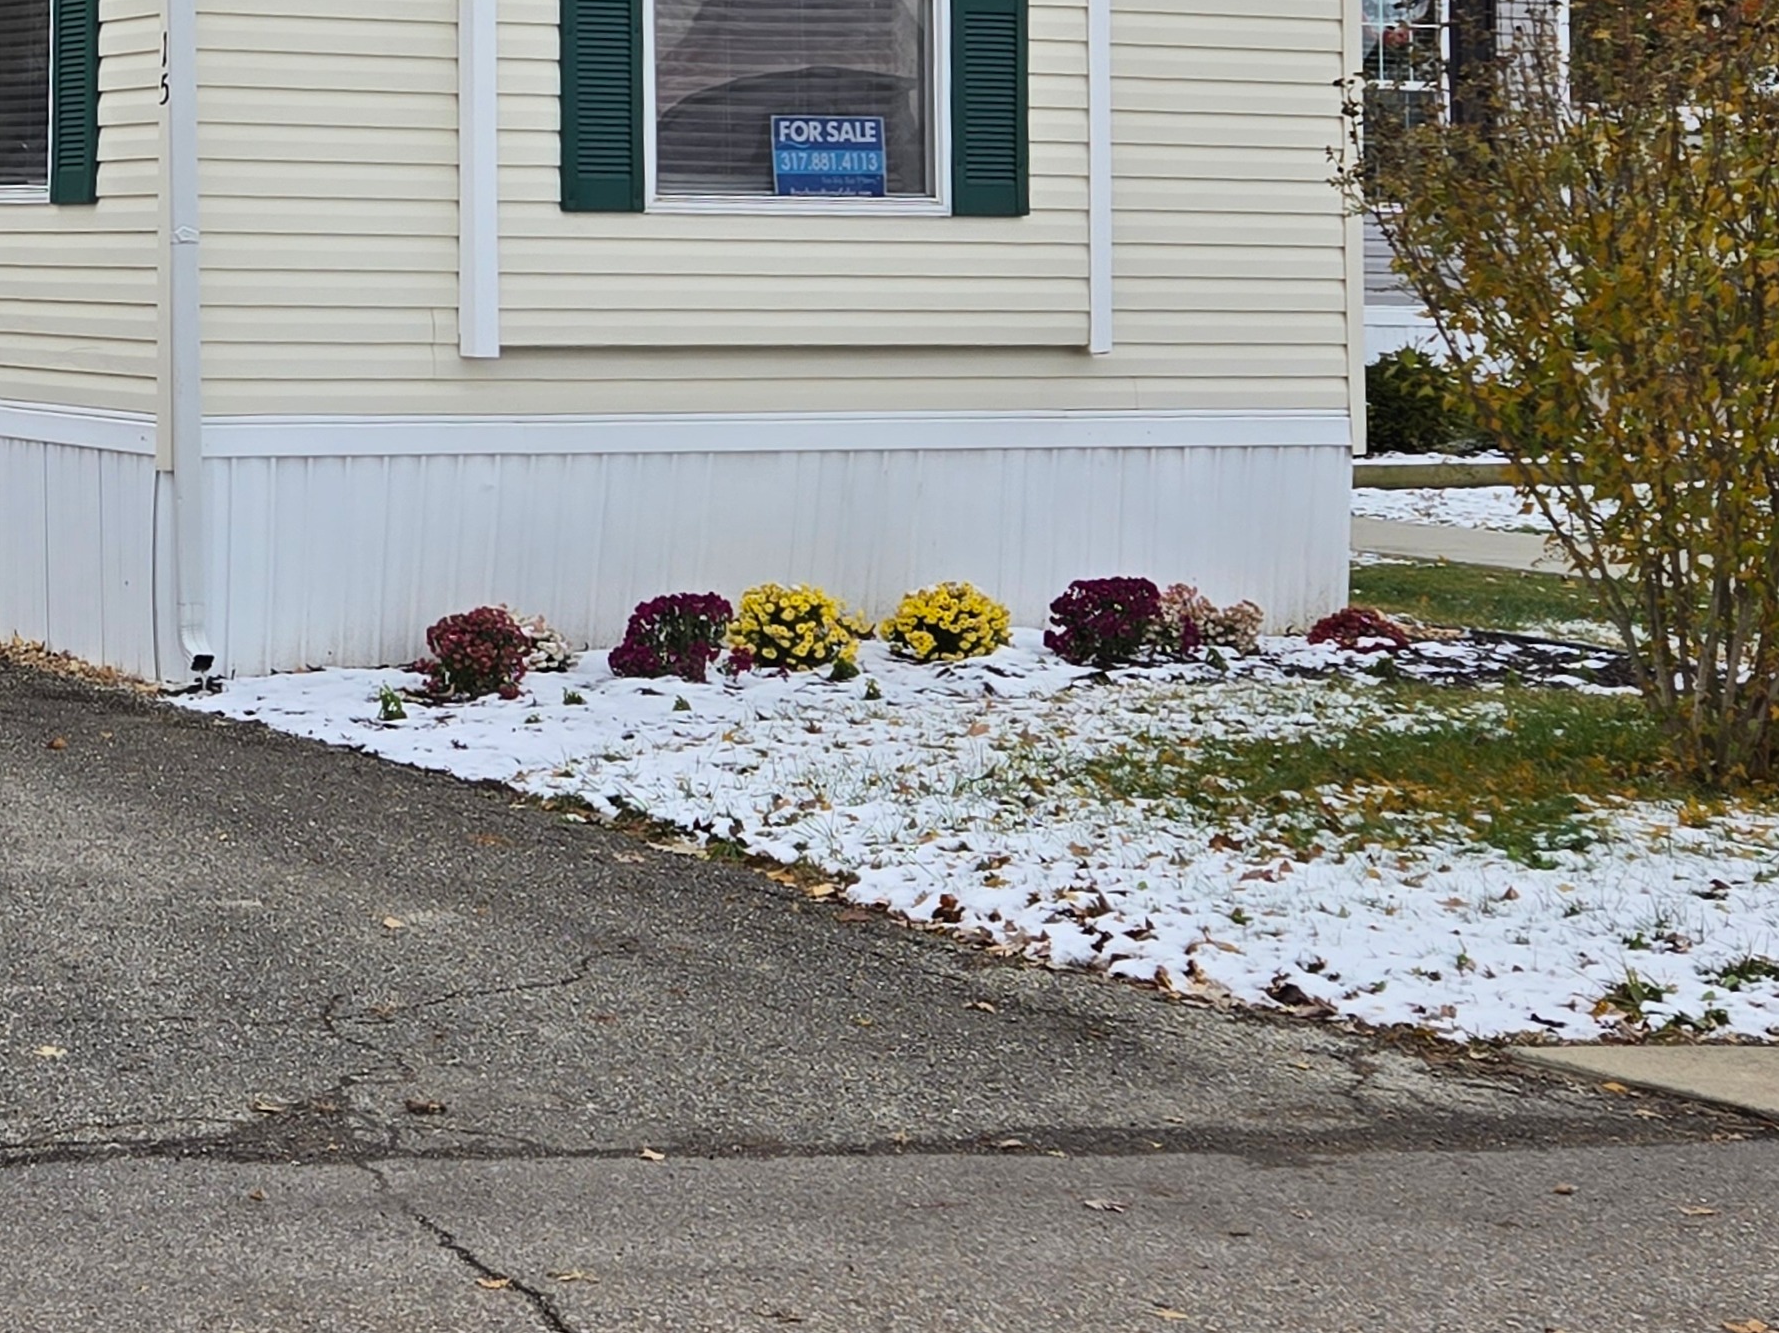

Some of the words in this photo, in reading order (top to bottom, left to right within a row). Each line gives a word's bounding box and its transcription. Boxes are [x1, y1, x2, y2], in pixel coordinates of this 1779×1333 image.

[779, 120, 824, 143] FOR
[826, 121, 877, 143] SALE
[780, 152, 878, 171] 317.881.4113
